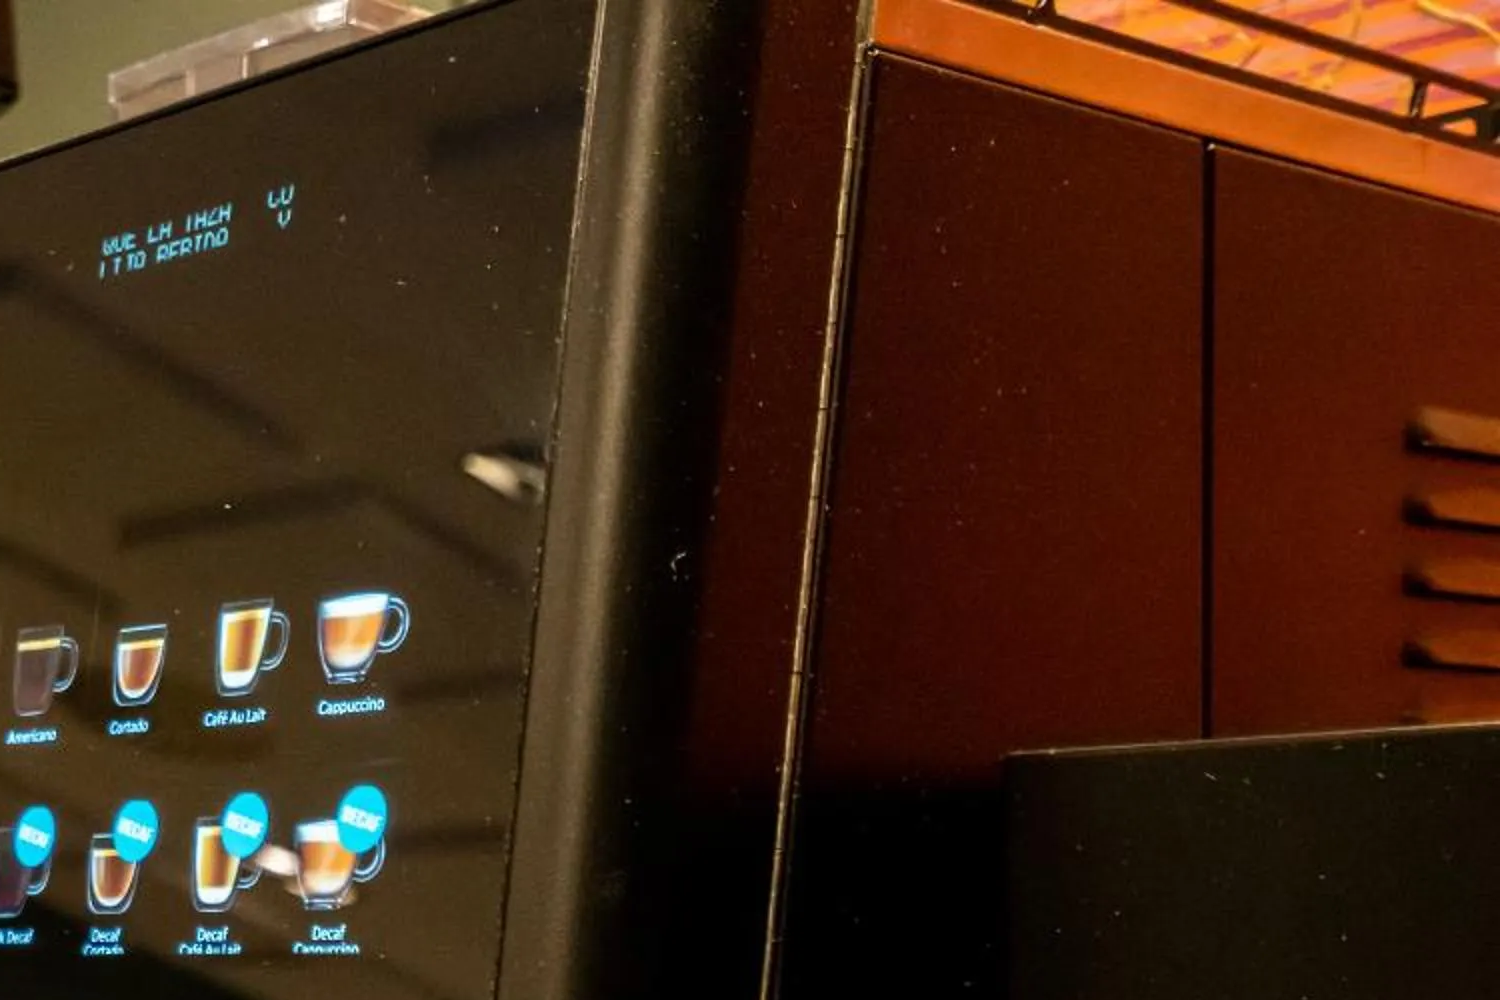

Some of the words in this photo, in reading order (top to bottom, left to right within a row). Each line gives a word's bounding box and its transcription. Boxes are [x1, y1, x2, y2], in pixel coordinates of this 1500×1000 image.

[317, 696, 385, 716] Cappuccino
[203, 710, 227, 727] Café
[229, 710, 245, 725] Au
[246, 708, 267, 723] Lait
[109, 719, 149, 735] Cortado
[6, 729, 57, 745] Americano
[6, 928, 35, 944] Decaf
[90, 927, 121, 943] Decaf
[196, 926, 229, 942] Decaf
[311, 924, 347, 941] Decaf
